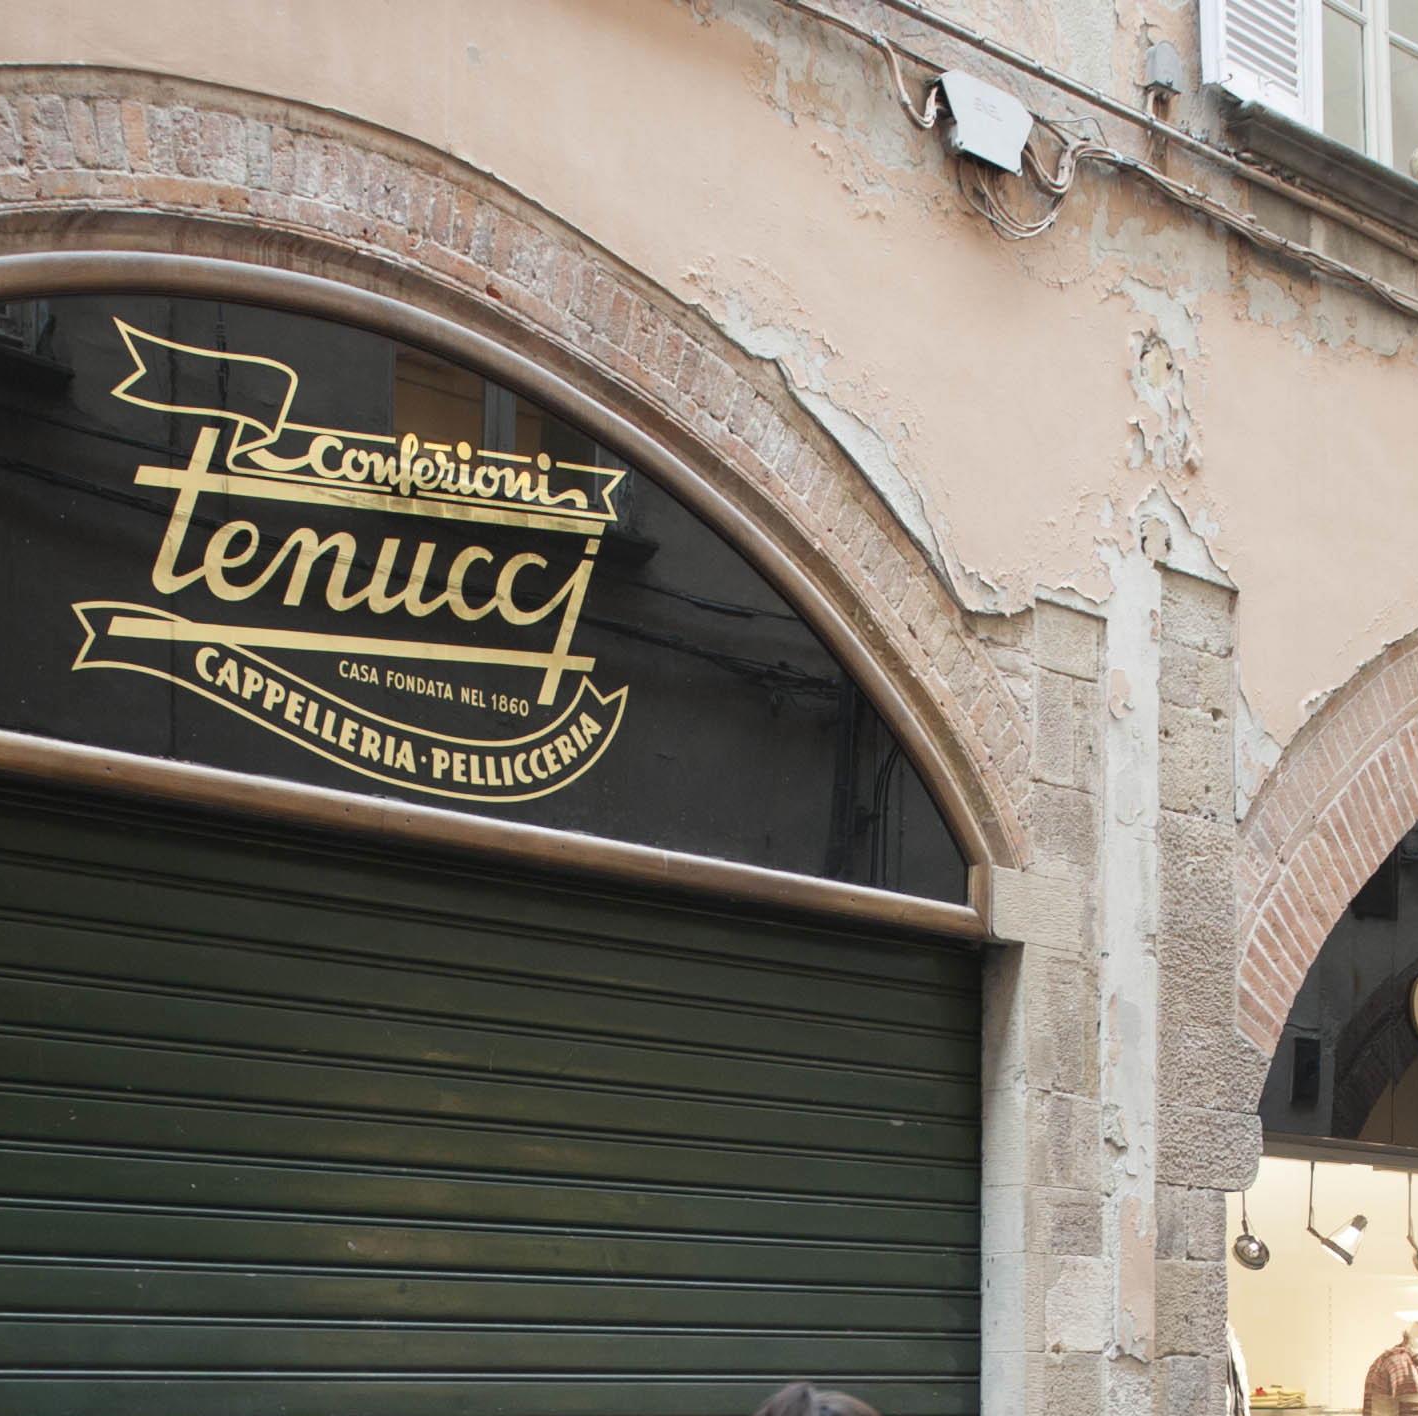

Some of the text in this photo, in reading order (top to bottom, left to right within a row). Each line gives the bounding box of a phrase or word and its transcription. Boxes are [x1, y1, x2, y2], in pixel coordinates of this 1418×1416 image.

[338, 659, 530, 718] CASA FONDATA NEL 1860
